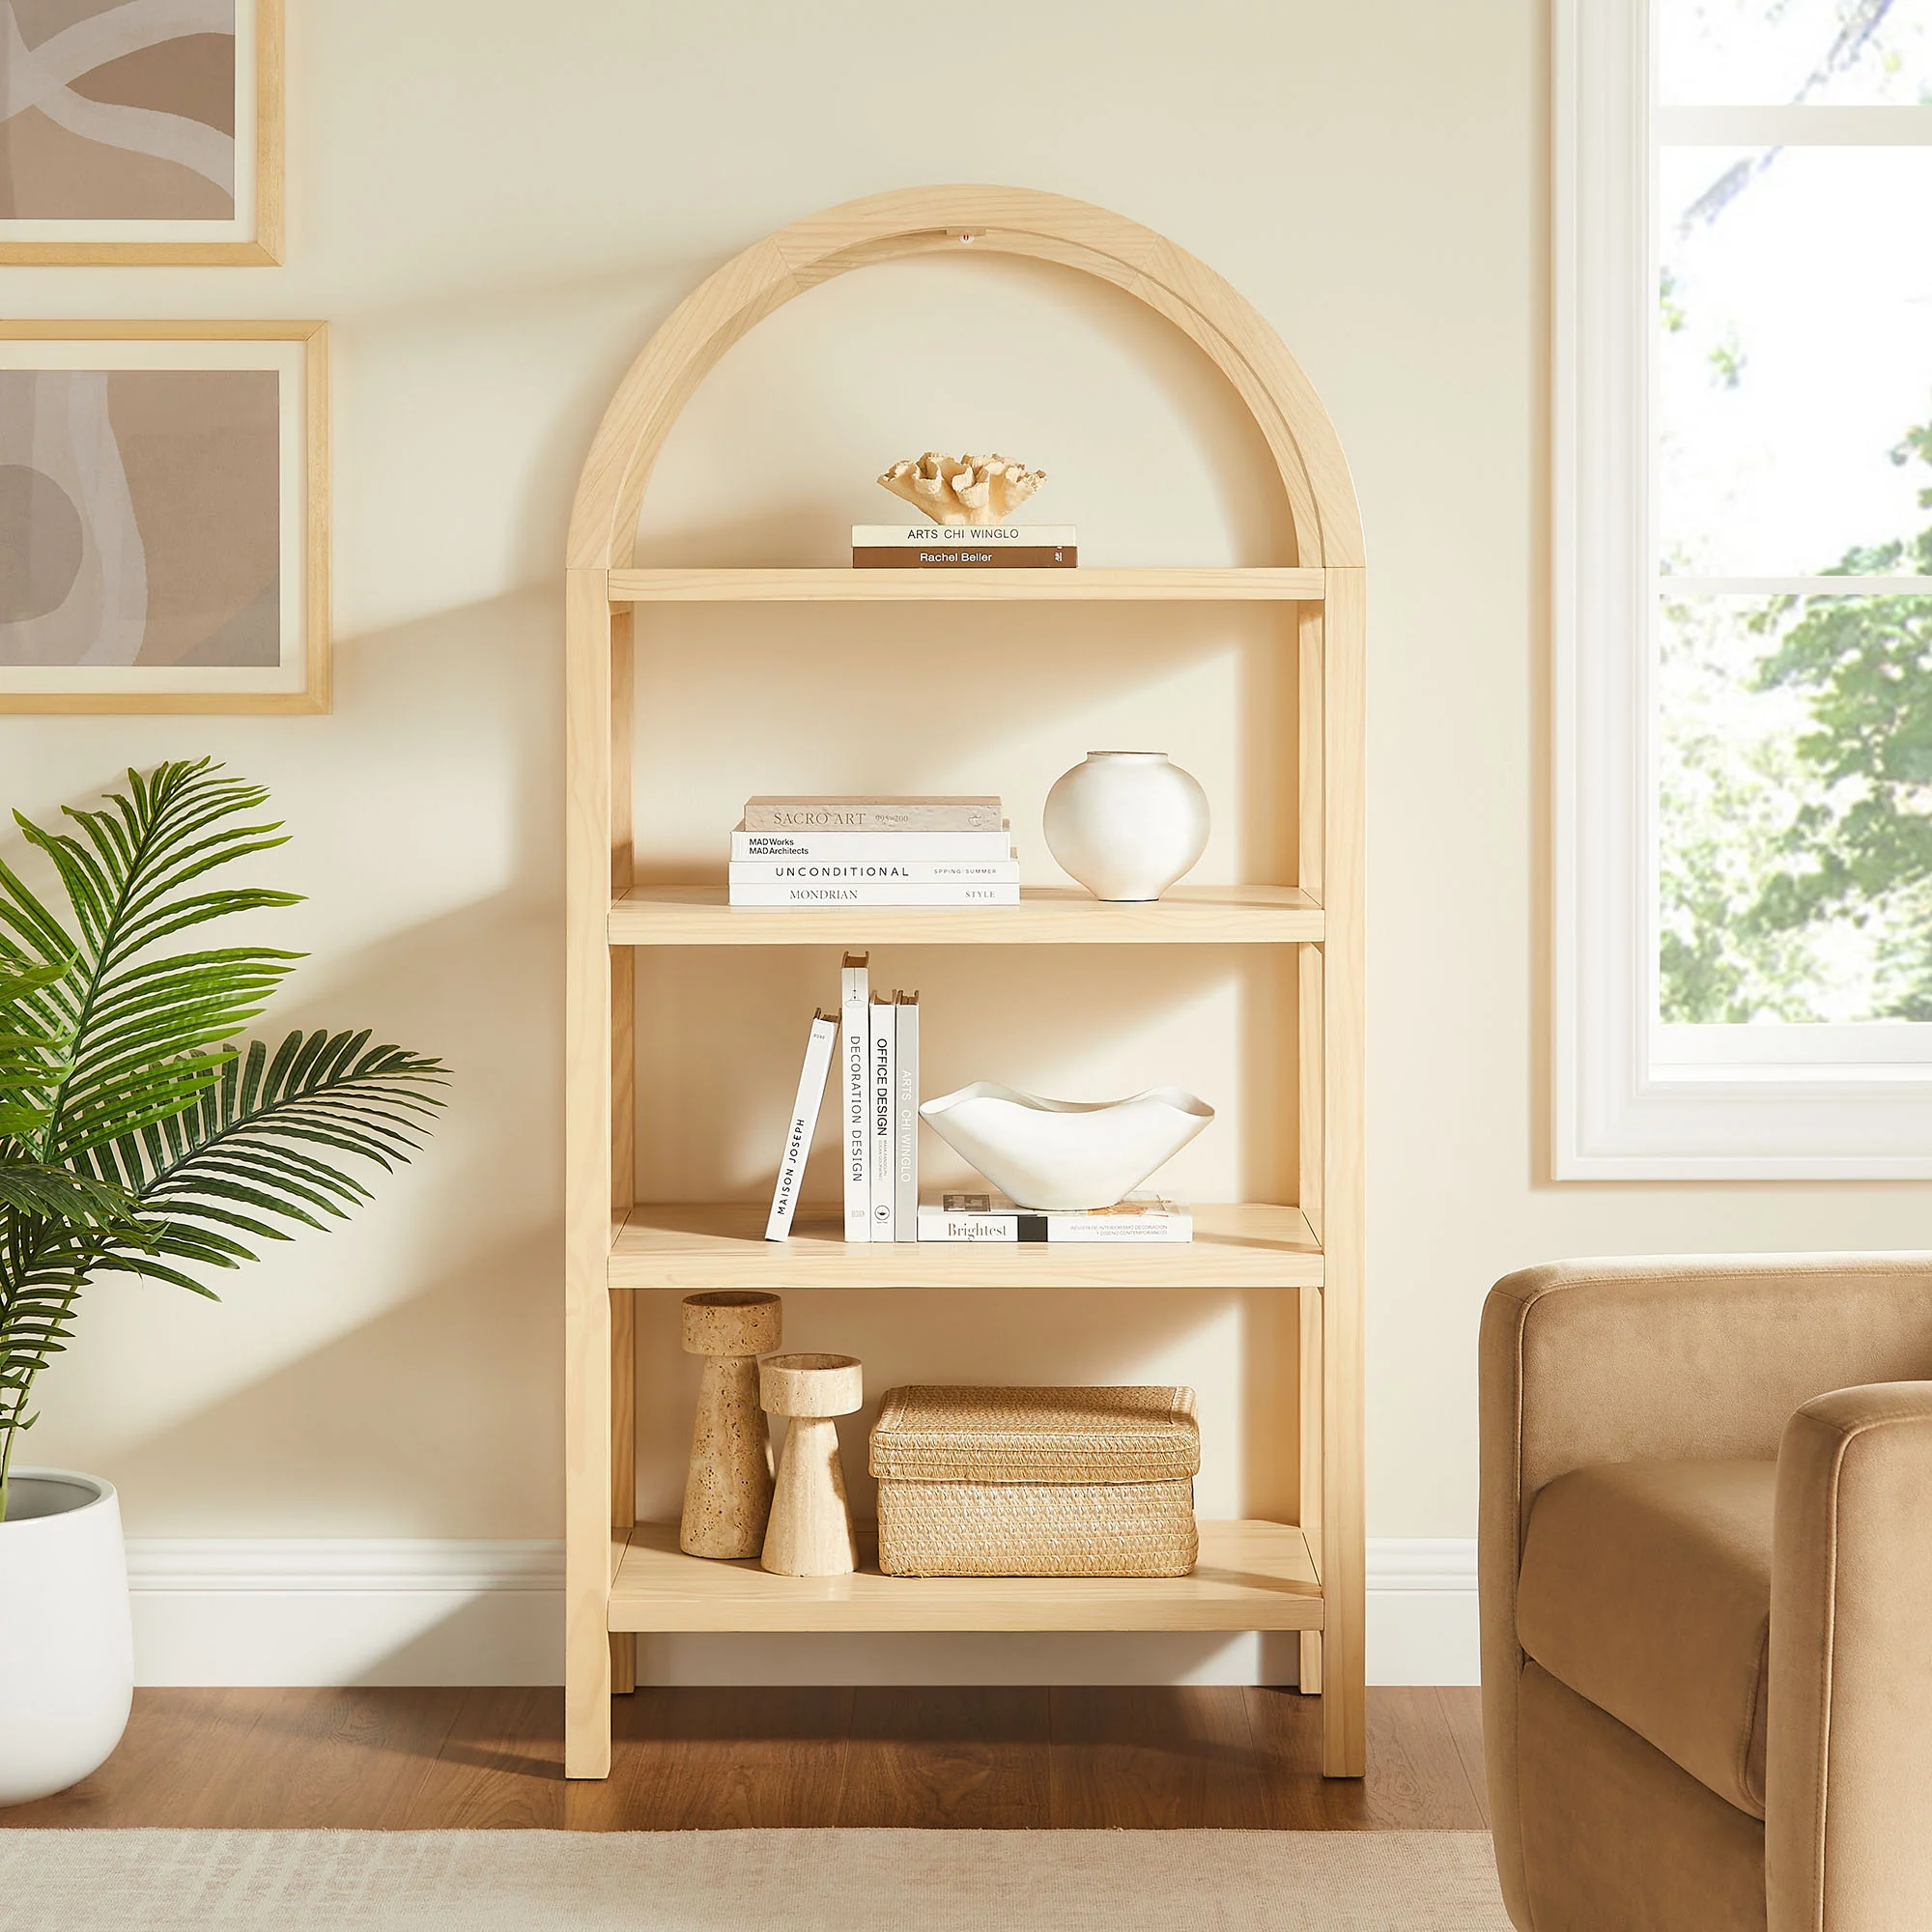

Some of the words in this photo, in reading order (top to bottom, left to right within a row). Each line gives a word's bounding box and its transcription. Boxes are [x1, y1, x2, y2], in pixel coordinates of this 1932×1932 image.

[907, 528, 939, 539] ARTS
[943, 528, 965, 539] CHI
[970, 528, 1019, 539] WINGLO
[920, 553, 958, 562] Rachel
[960, 553, 993, 562] Beller
[773, 812, 829, 826] SACRO
[834, 812, 867, 825] ART
[775, 867, 910, 877] UNCONDITIONAL
[789, 890, 858, 900] MONDRIAN
[965, 890, 997, 898] STYLE
[876, 1037, 888, 1085] OFFICE
[850, 1036, 862, 1123] DECORATION
[900, 1069, 912, 1101] ARTS
[876, 1089, 888, 1136] DESIGN
[900, 1110, 912, 1131] CHI
[777, 1168, 794, 1215] MAISON
[788, 1119, 805, 1164] JOSEPH
[851, 1130, 863, 1181] DESIGN
[900, 1134, 912, 1182] WINGLO
[948, 1222, 1007, 1240] Brightest
